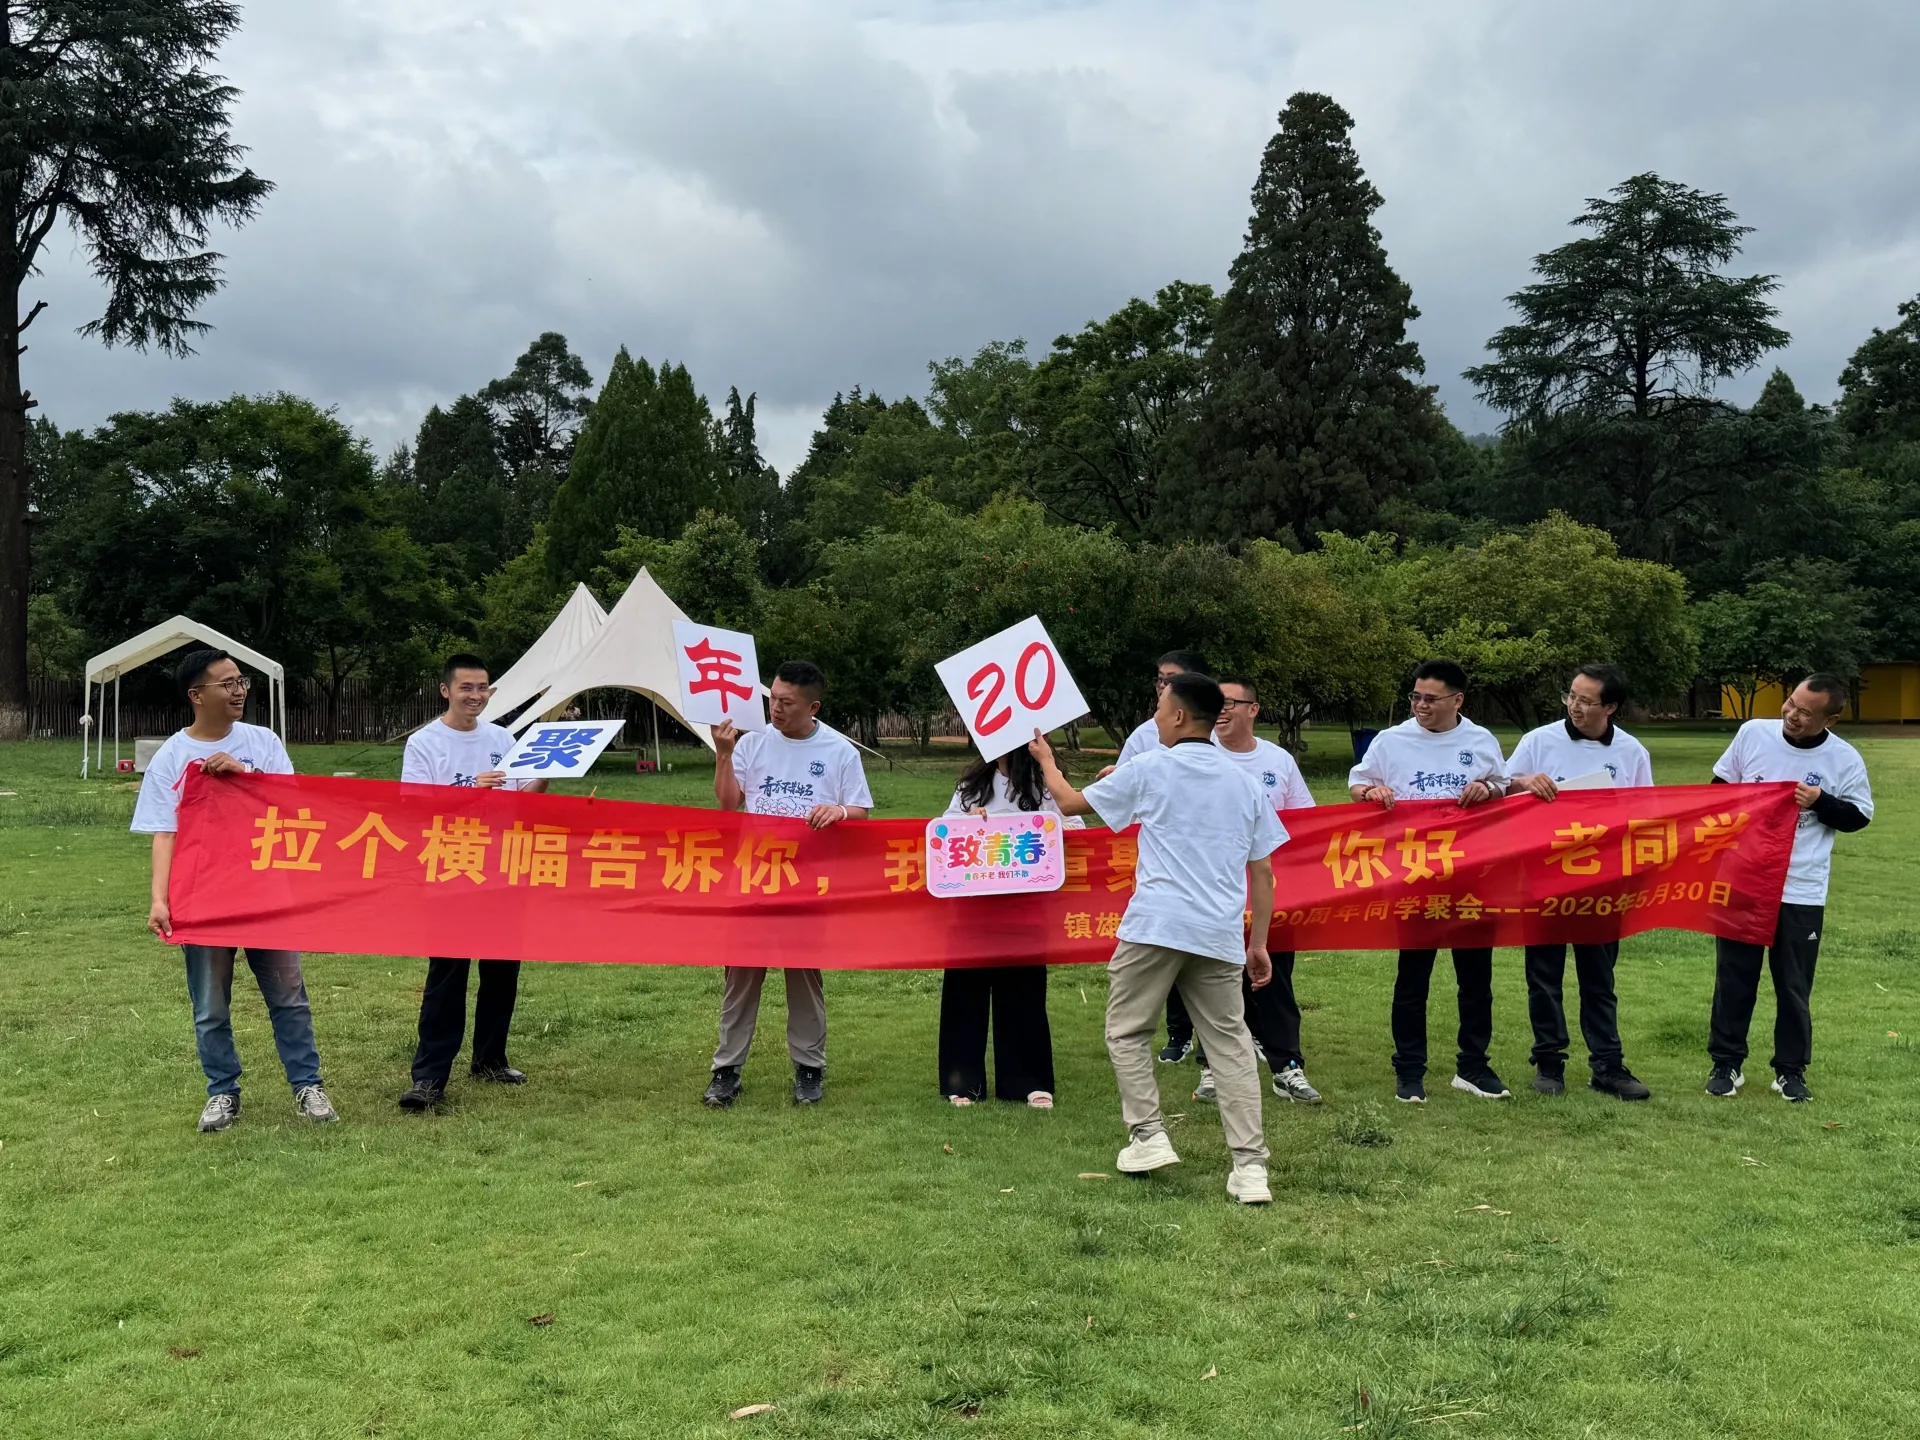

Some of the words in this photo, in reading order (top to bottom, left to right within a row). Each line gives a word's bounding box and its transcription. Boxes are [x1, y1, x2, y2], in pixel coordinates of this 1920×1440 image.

[684, 637, 753, 714] 年
[967, 641, 1056, 737] 20
[509, 728, 604, 770] 聚
[947, 831, 1047, 869] 致青春
